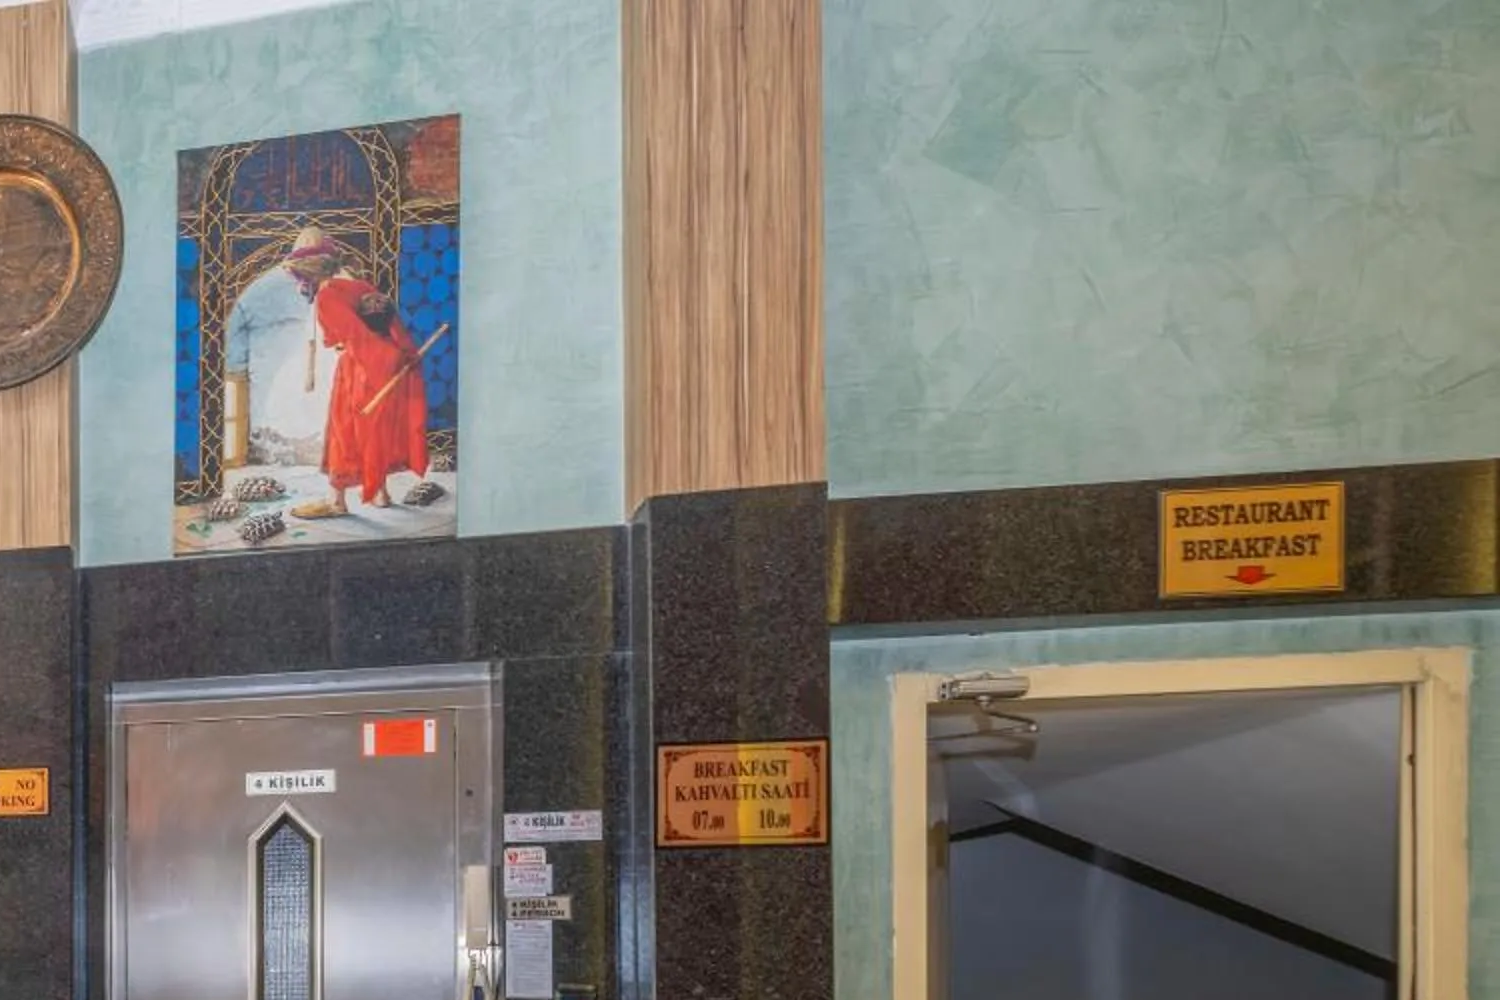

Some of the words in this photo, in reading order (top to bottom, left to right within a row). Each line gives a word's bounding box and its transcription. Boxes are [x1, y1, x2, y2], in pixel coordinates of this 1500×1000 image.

[1173, 499, 1330, 528] RESTAURANT
[1181, 533, 1321, 562] BREAKFAST
[694, 759, 790, 778] BREAKFAST
[16, 779, 36, 791] NO
[674, 783, 757, 802] KAHVALTI
